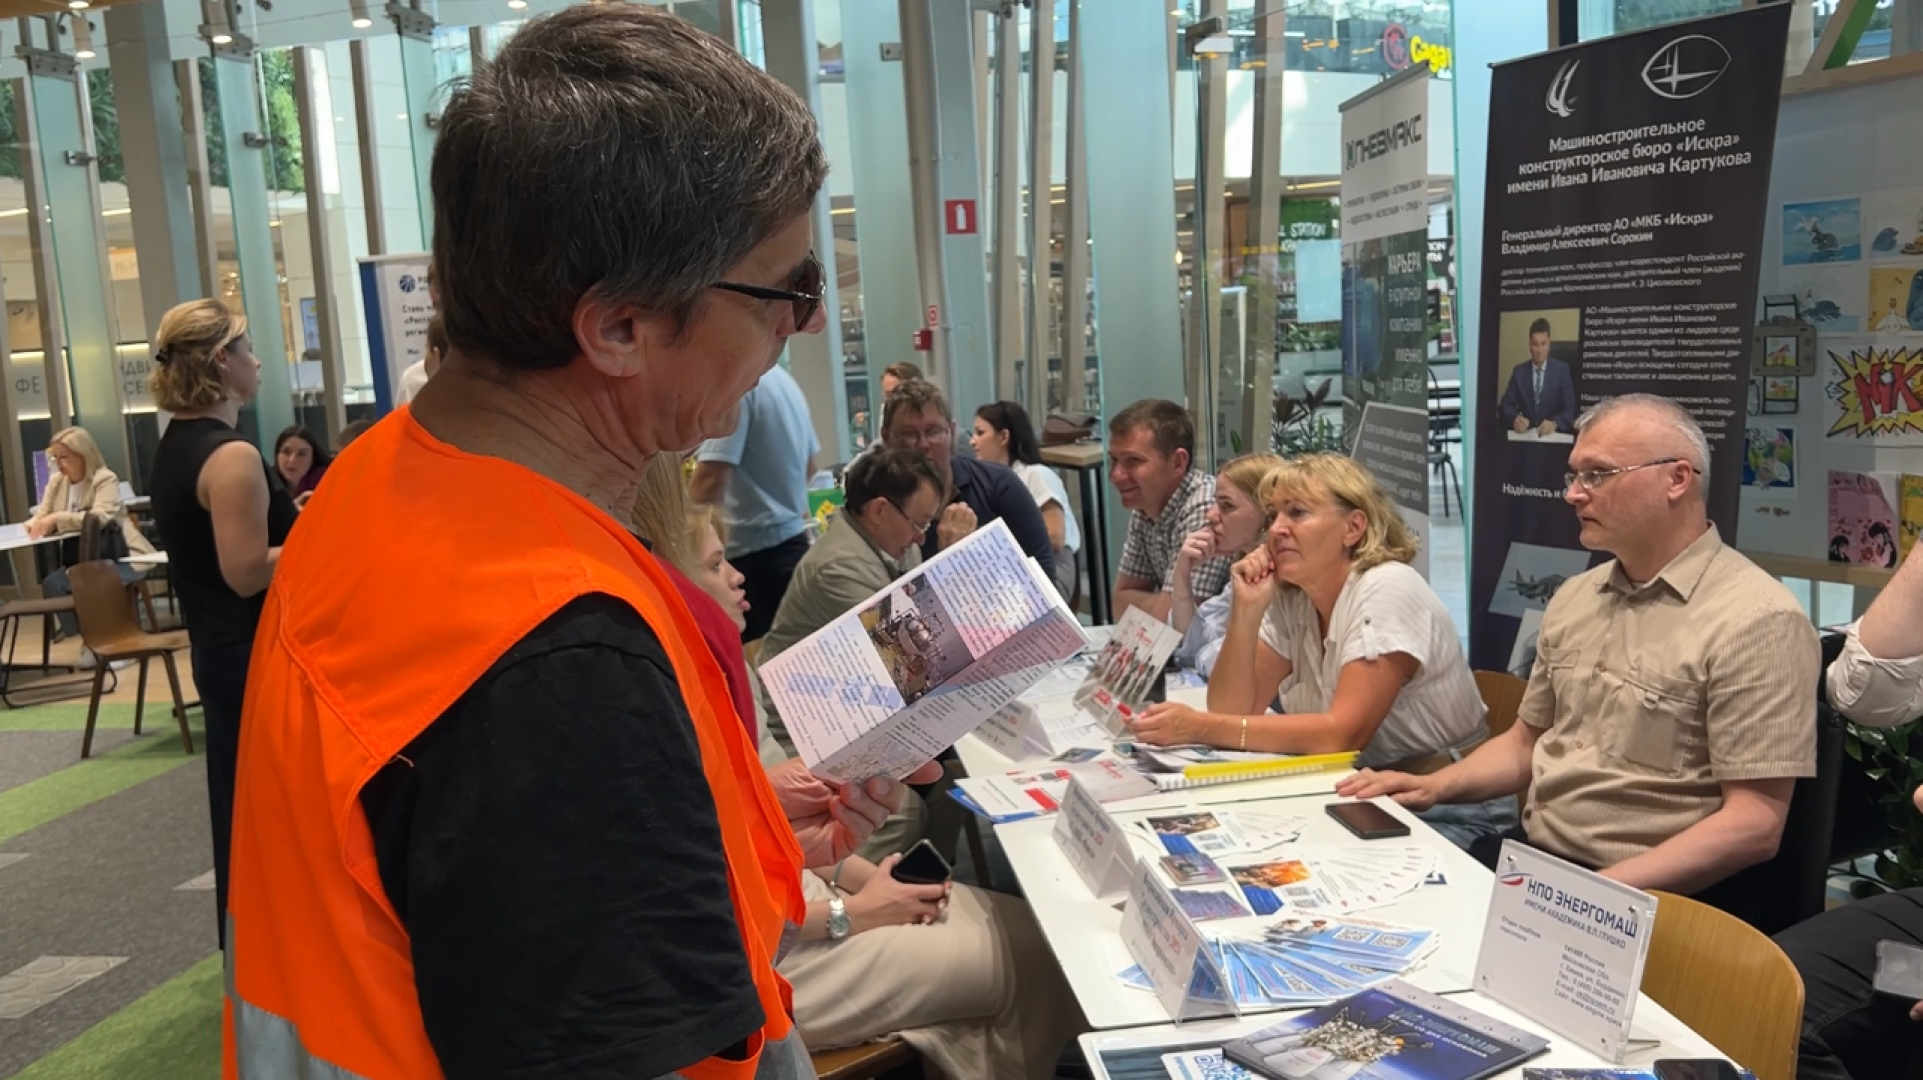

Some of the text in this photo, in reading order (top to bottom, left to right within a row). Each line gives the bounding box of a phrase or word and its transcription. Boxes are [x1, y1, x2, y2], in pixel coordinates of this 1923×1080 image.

[1549, 118, 1706, 153] Машиностроительное
[1518, 134, 1740, 175] конструкторское бюро «Искра»
[1507, 151, 1752, 194] имени Ивана Ивановича Картукова
[1501, 212, 1714, 242] Генеральный директор АО «МКБ «Искра»
[1501, 232, 1653, 255] Владимир Алексеевич Сорокин
[1524, 898, 1547, 914] ИМЕНИ
[1546, 907, 1587, 932] АКАДЕМИКА
[1527, 878, 1638, 939] НПО ЭНЕРГОМАШ
